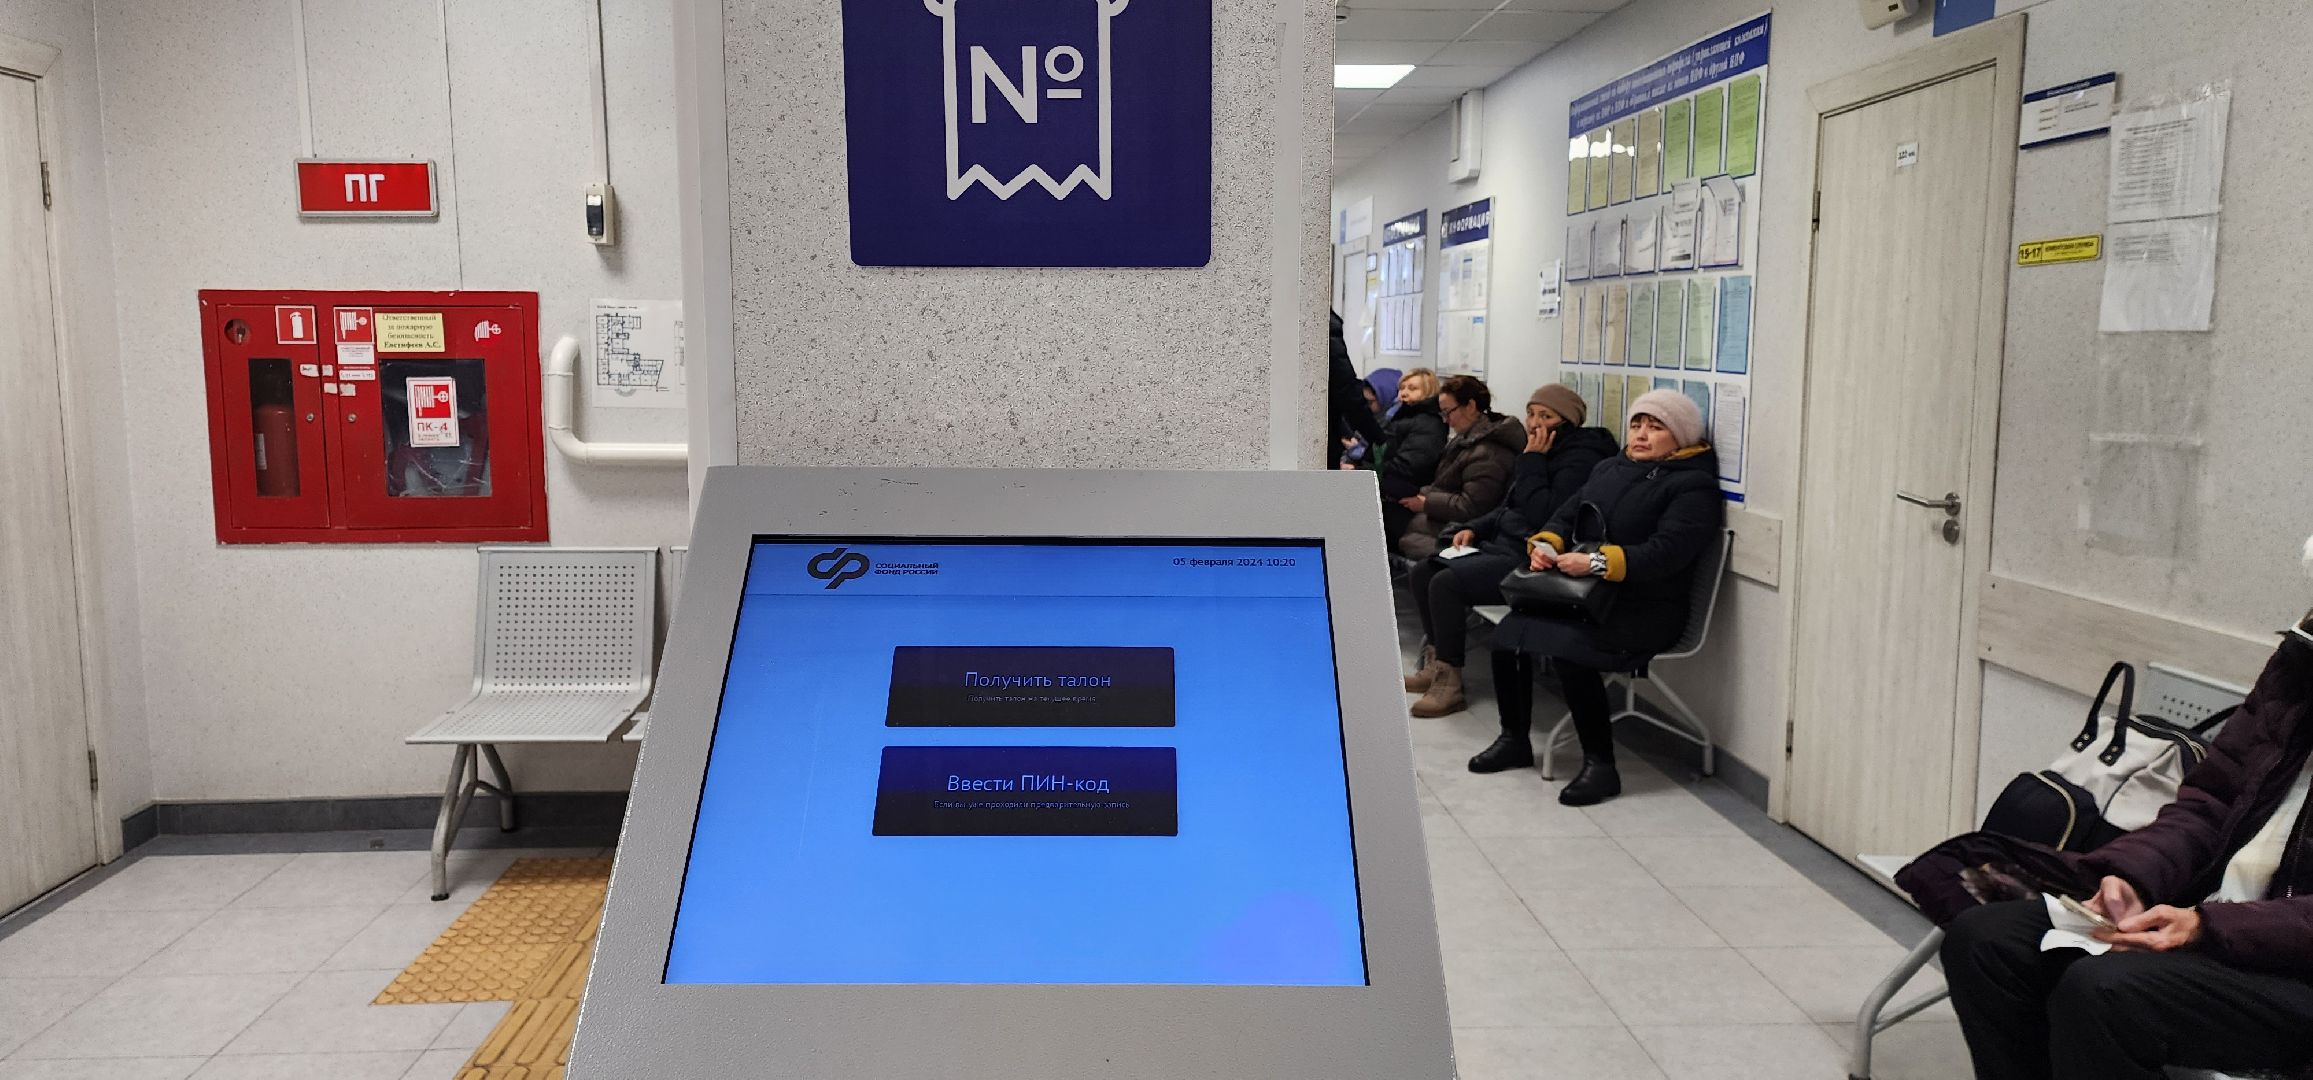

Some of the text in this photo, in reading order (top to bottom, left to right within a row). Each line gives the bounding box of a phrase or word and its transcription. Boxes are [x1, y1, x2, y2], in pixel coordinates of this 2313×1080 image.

[344, 173, 385, 202] ПГ
[875, 562, 939, 570] СОЦИАЛЬНЫЙ
[1172, 557, 1297, 568] 05 февраля 2024 10:20
[965, 672, 1111, 690] Получить талон
[947, 774, 1110, 794] Ввести ПИН-код
[934, 800, 953, 808] Если
[985, 801, 1029, 810] проходили
[1030, 801, 1101, 810] предварительную
